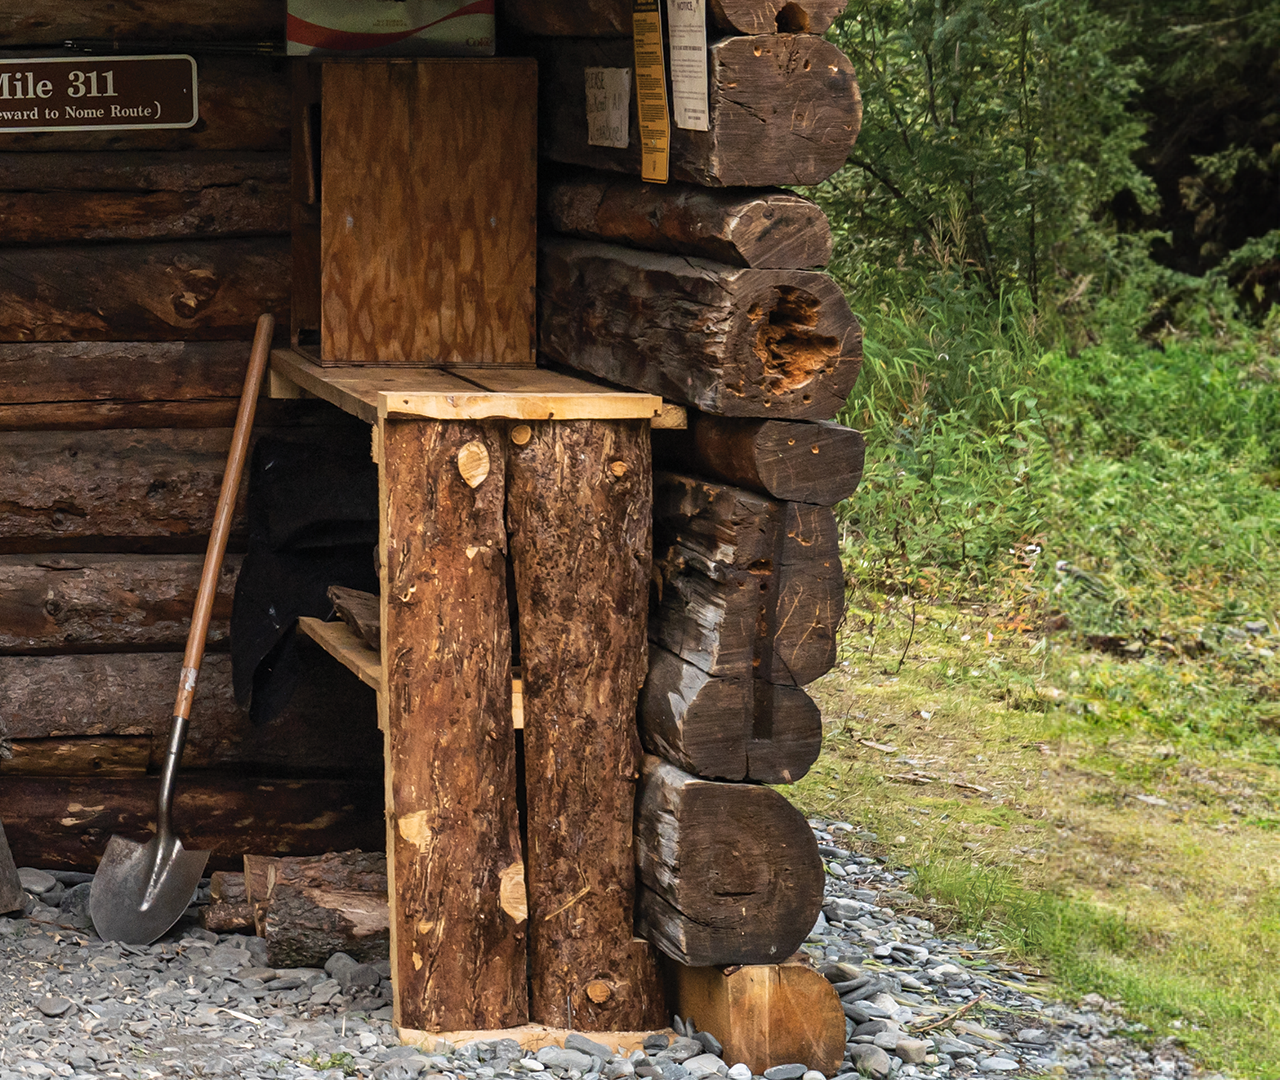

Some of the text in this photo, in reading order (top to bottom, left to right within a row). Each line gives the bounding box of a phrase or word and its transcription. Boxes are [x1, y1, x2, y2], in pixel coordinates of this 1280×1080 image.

[677, 1, 693, 11] NOTICE
[67, 70, 118, 98] 311
[44, 107, 59, 119] to
[65, 106, 105, 119] Nome
